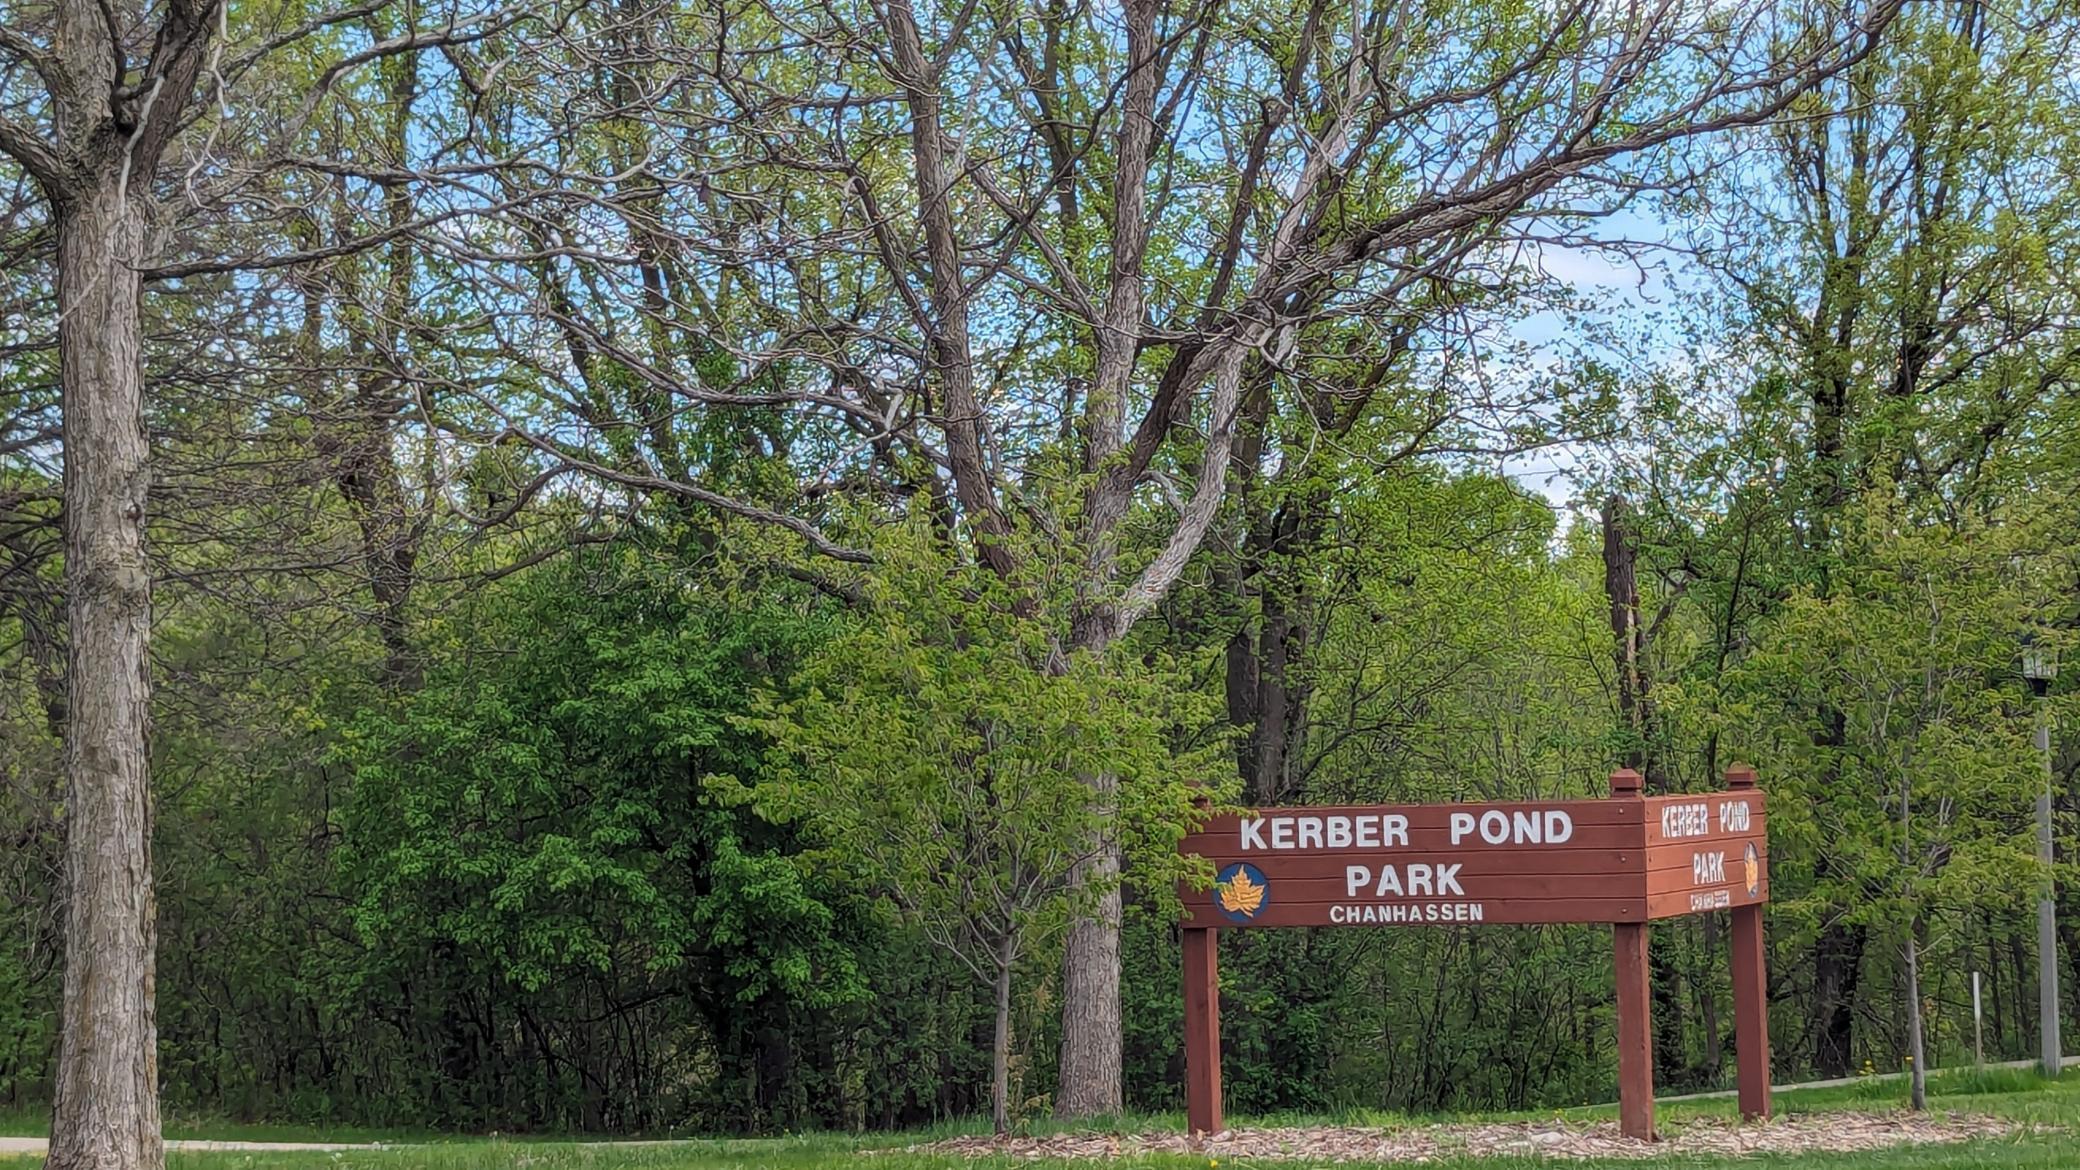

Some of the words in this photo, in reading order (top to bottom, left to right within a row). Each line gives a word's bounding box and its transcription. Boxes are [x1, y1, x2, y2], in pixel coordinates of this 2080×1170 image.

[1240, 814, 1409, 850] KERBER
[1450, 810, 1573, 845] POND
[1661, 804, 1708, 838] KERBER
[1720, 801, 1750, 832] POND
[1346, 863, 1465, 897] PARK
[1693, 852, 1726, 884] PARK
[1329, 903, 1483, 923] CHANHASSEN
